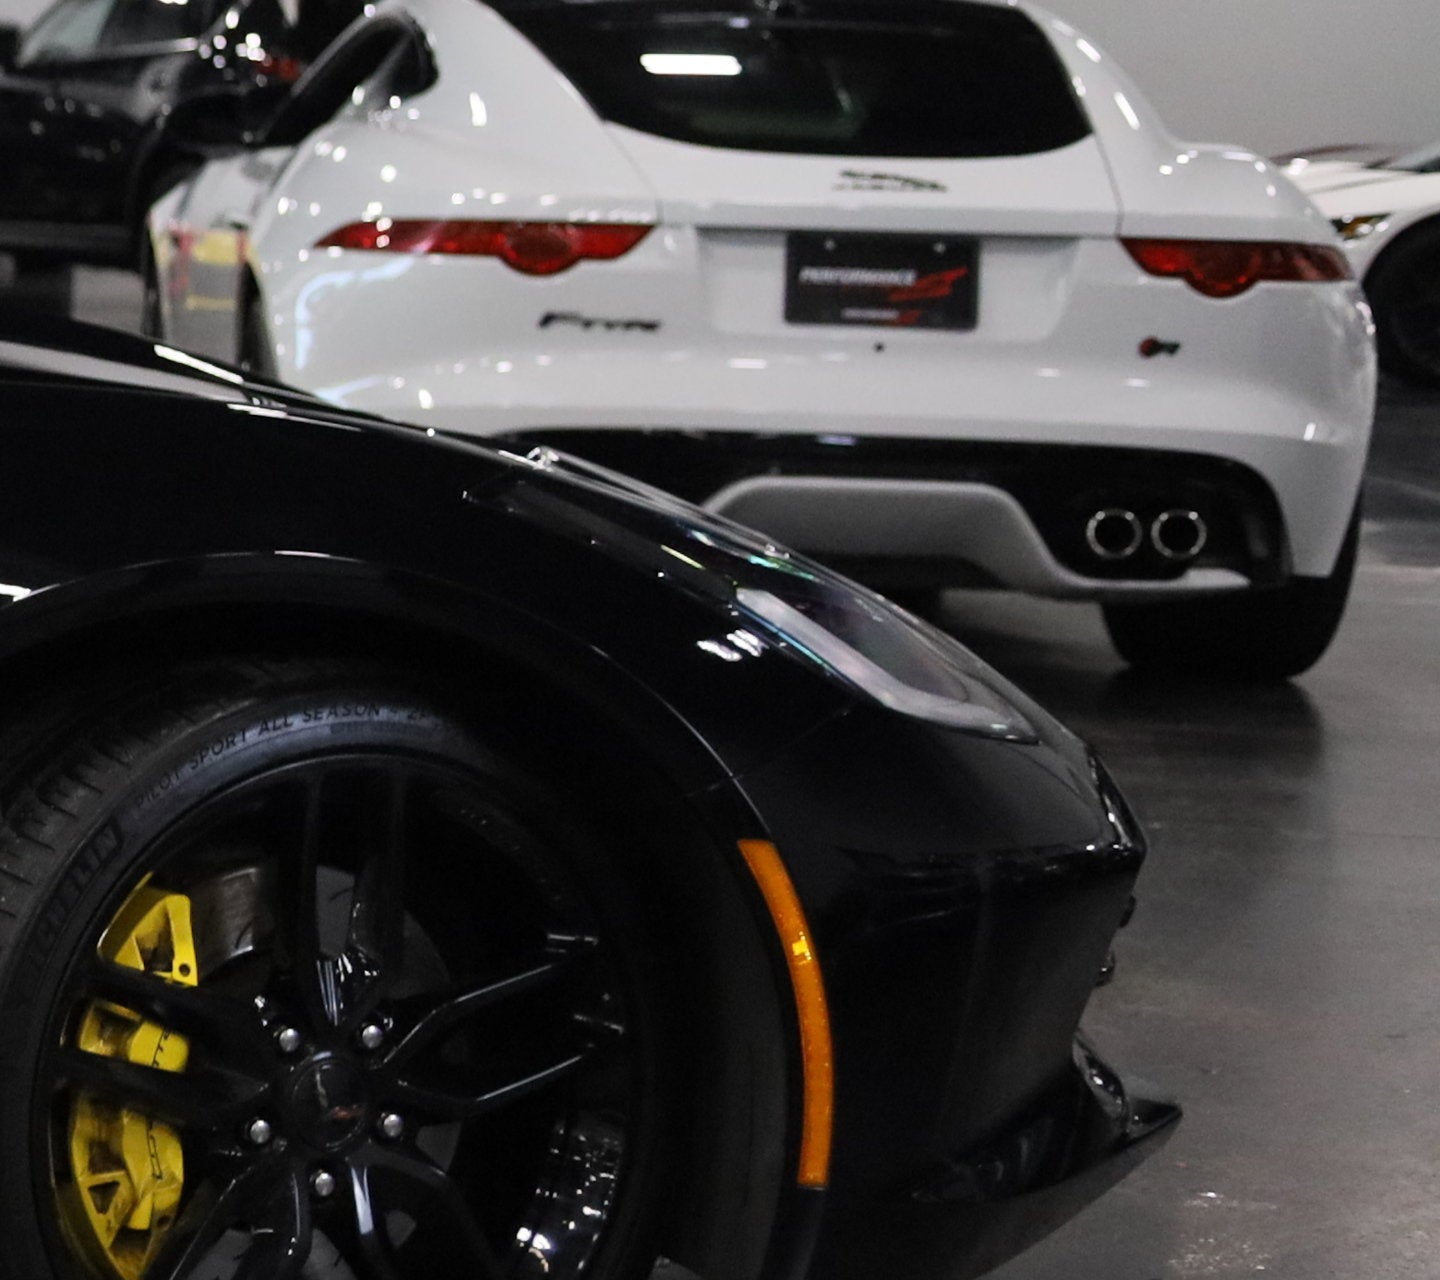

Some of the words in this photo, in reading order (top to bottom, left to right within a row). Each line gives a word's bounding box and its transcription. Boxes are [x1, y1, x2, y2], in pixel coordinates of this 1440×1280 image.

[136, 770, 180, 808] PILOT
[189, 729, 247, 770] SPORT
[258, 715, 294, 736] ALL
[302, 702, 380, 724] SEASON
